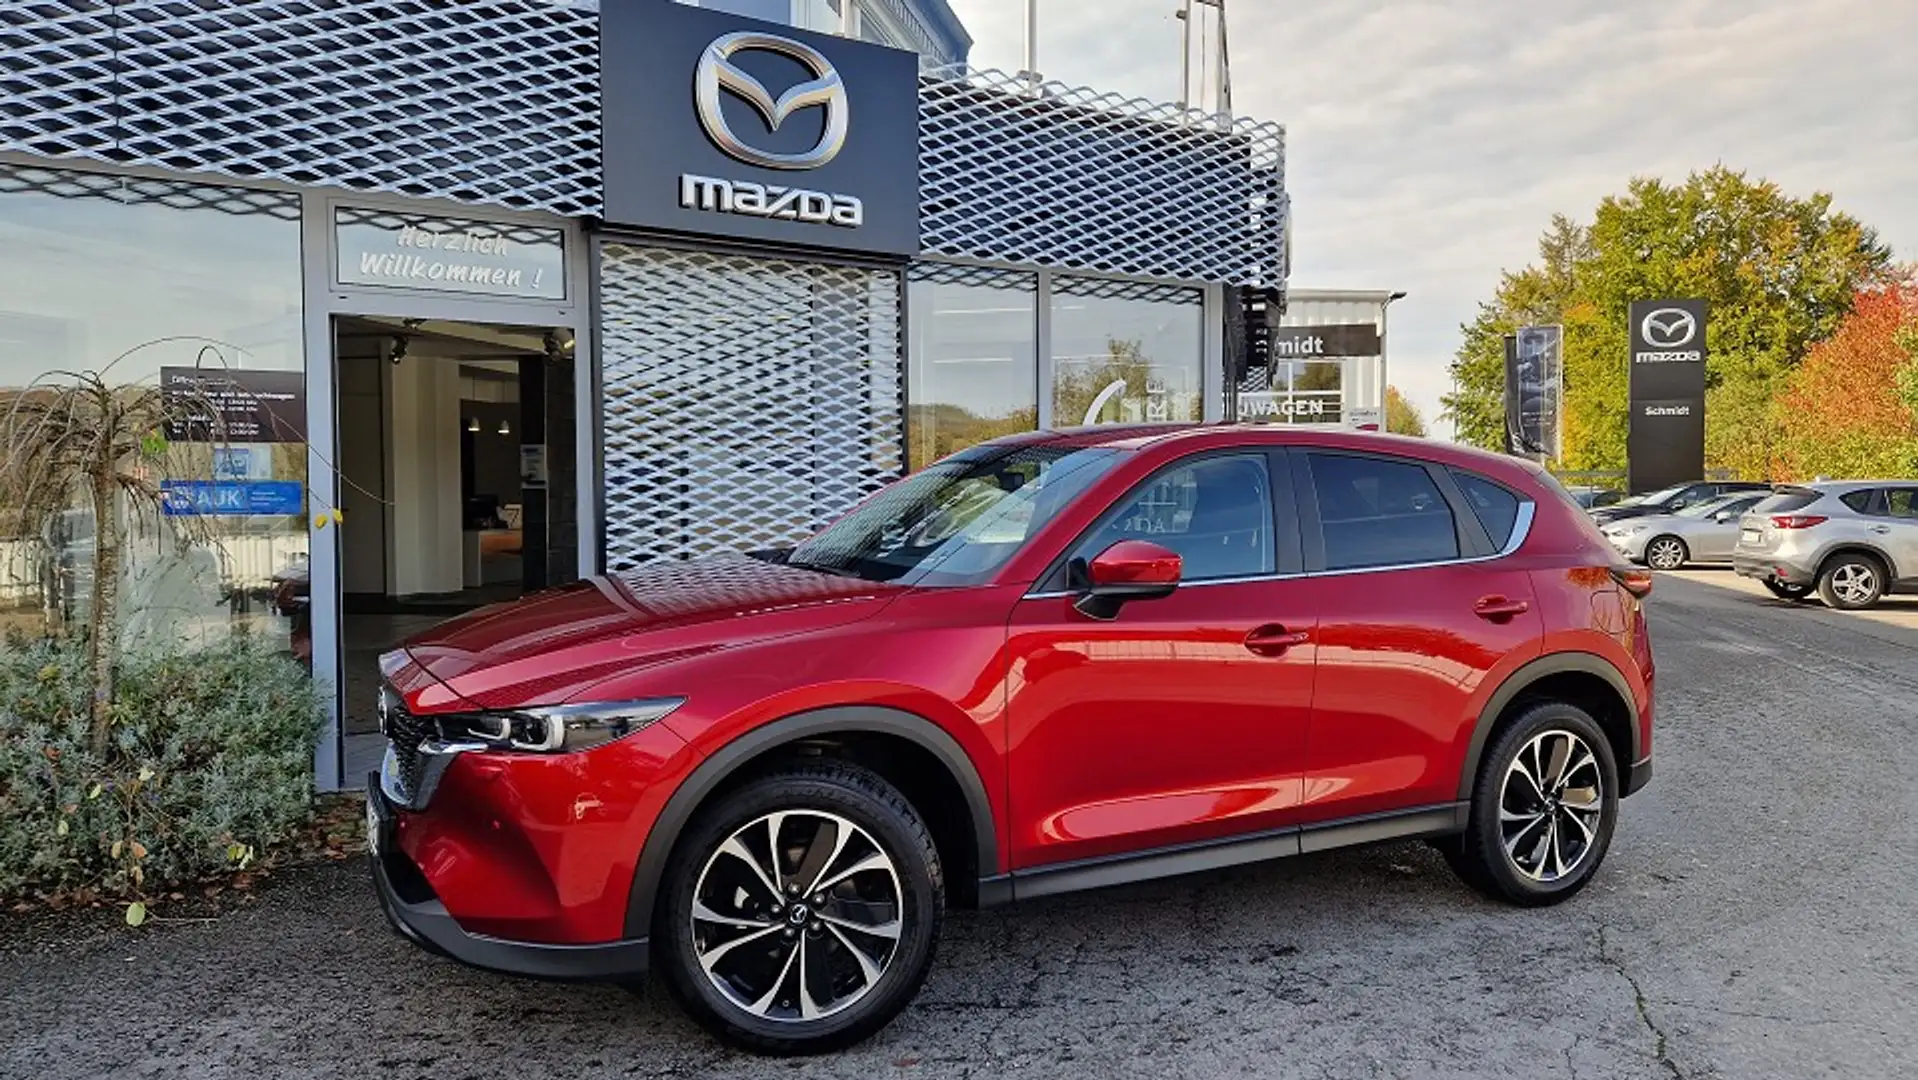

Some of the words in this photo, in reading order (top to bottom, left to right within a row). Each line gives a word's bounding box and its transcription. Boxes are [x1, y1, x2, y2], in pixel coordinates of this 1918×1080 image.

[398, 224, 508, 257] Herzlich
[360, 252, 522, 287] Willkommen
[531, 268, 544, 289] !
[1645, 406, 1690, 416] Schmidt
